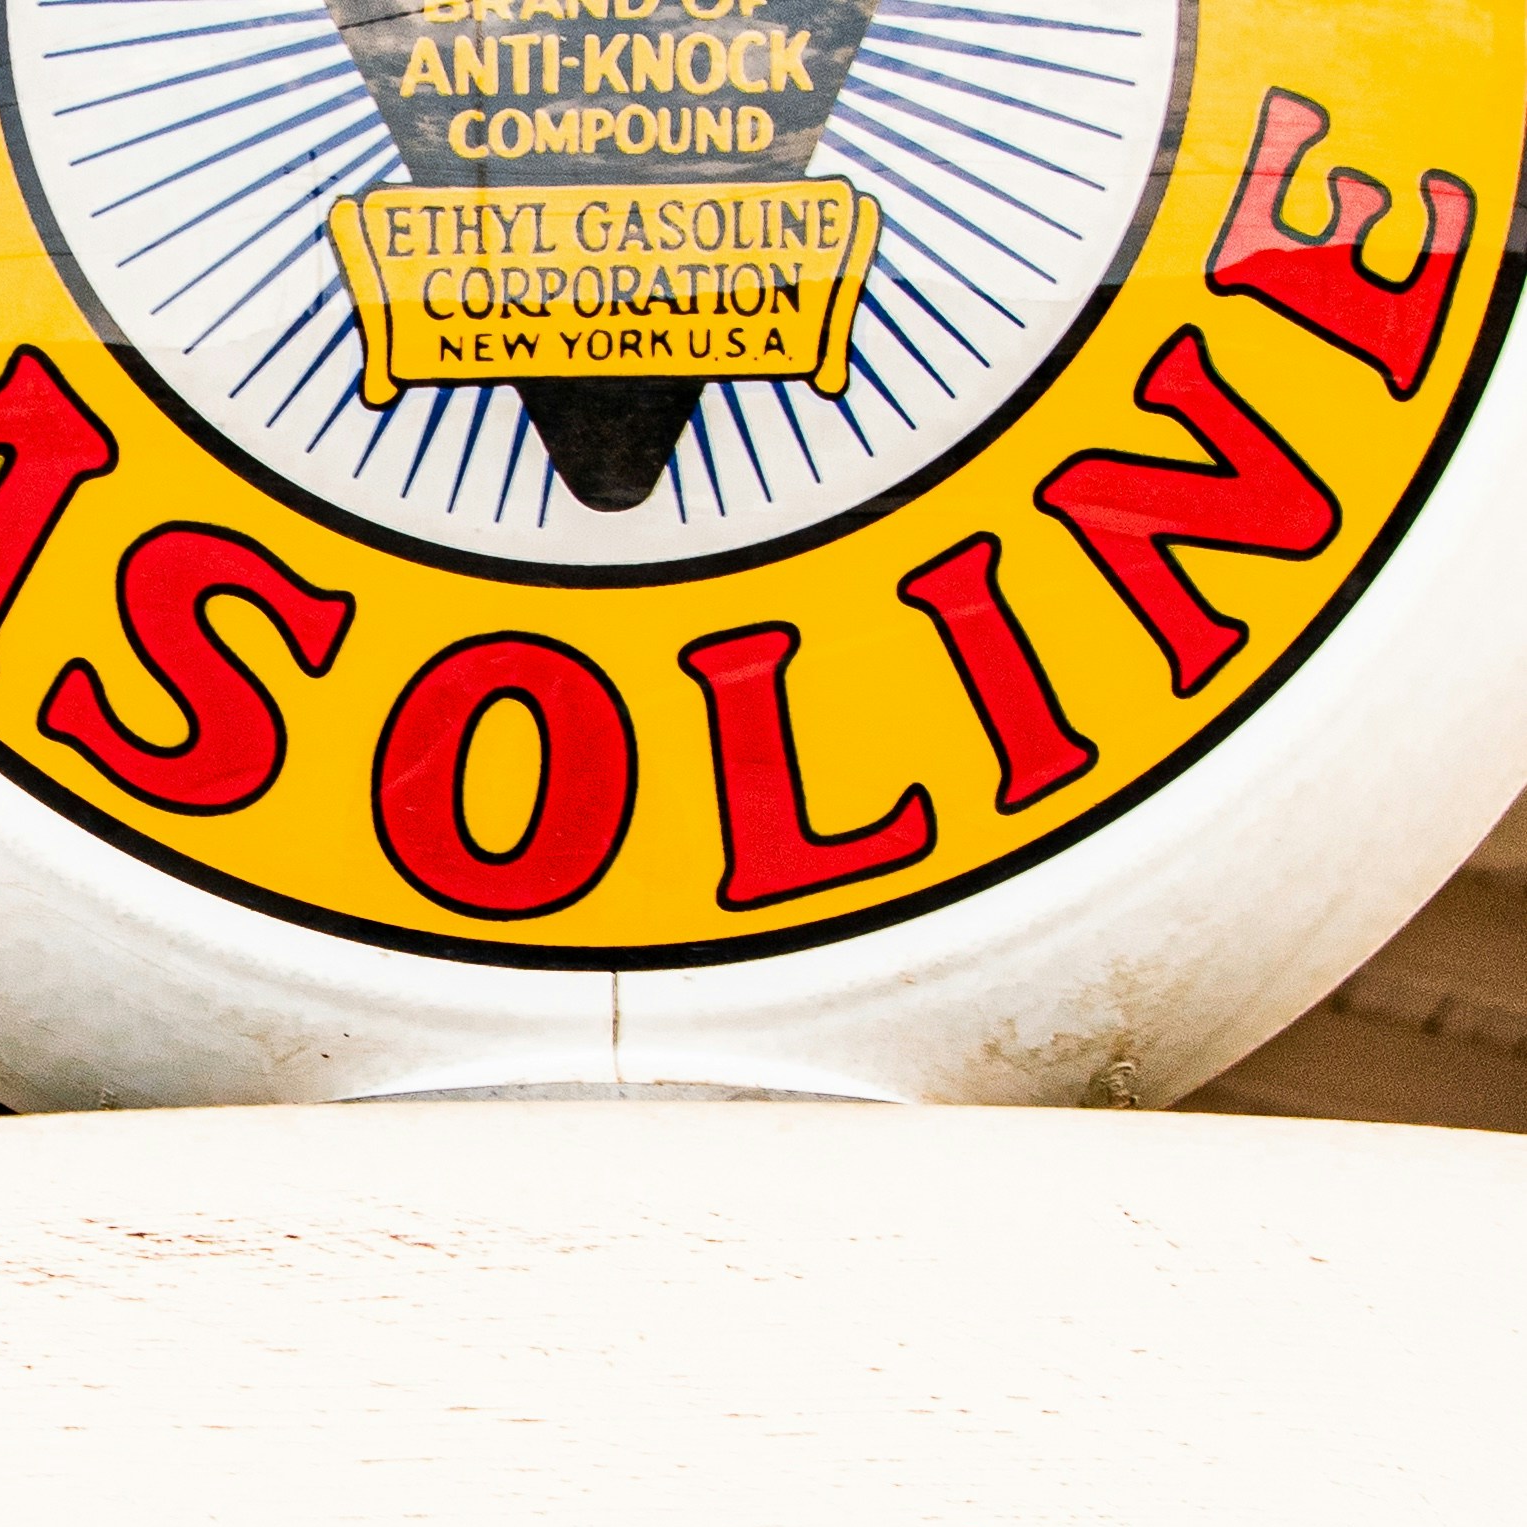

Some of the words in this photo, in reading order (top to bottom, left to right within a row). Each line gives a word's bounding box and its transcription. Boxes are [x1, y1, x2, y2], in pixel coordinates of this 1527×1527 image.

[399, 30, 815, 97] ANTI-KNOCK
[447, 104, 775, 159] COMPOUND
[383, 205, 558, 258] ETHYL
[575, 198, 842, 253] GASOLINE
[422, 262, 804, 321] CORPORATION
[438, 331, 542, 363] NEW
[558, 328, 675, 361] YORK
